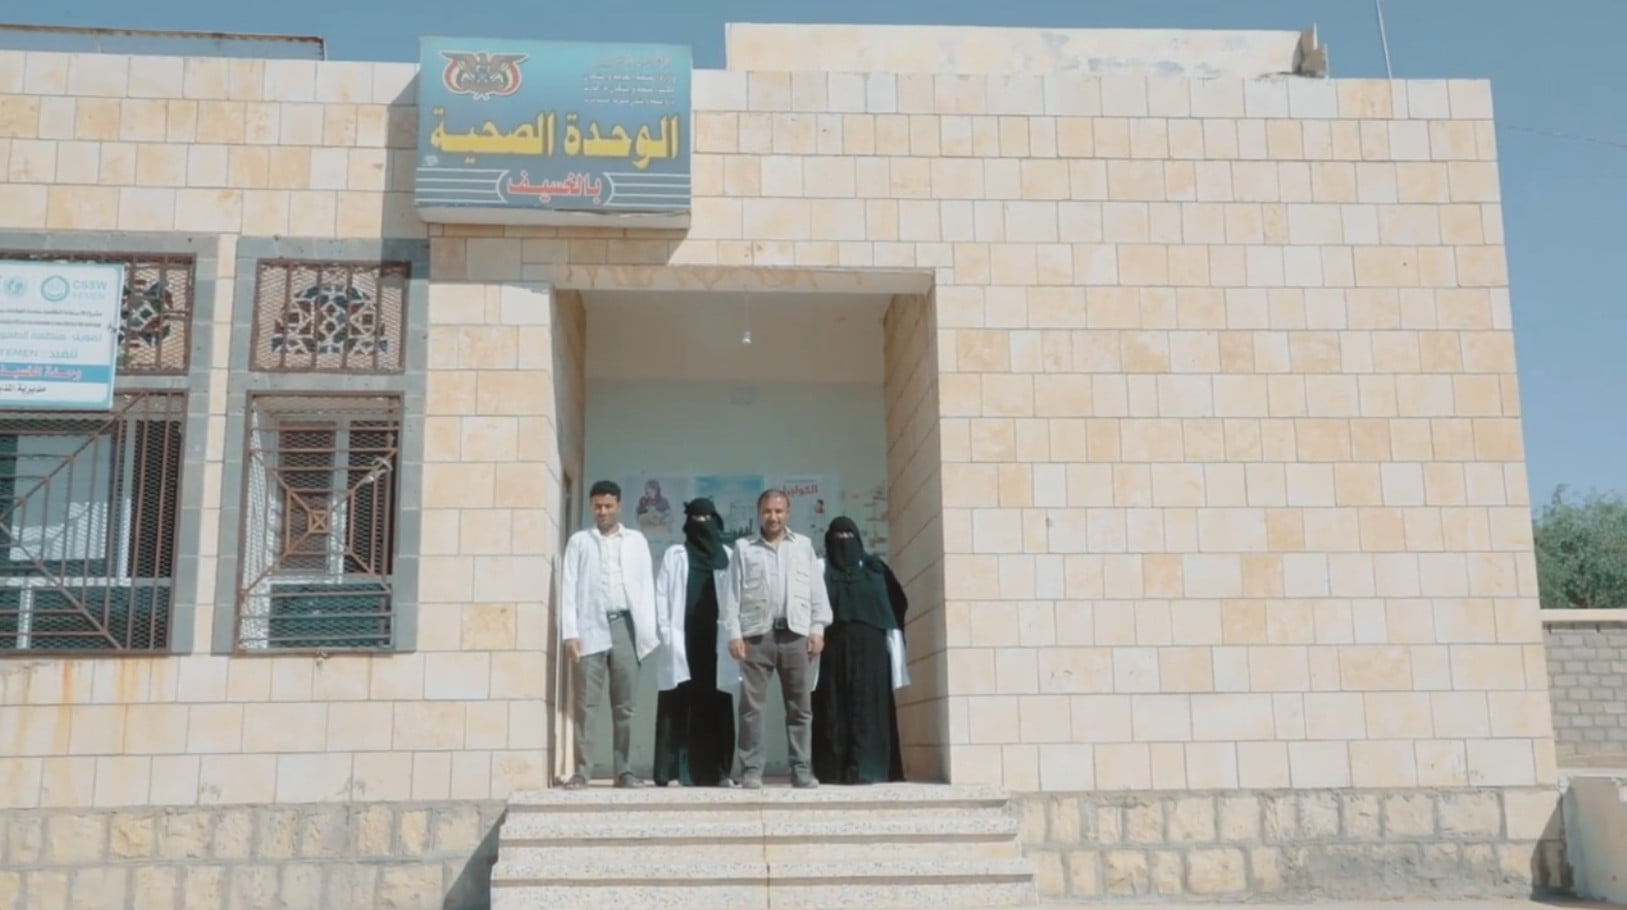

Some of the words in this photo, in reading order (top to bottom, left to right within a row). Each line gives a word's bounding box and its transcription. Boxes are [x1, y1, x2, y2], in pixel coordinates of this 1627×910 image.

[430, 107, 555, 164] الصحية
[564, 113, 678, 168] الوحدة
[72, 279, 108, 291] CSSW
